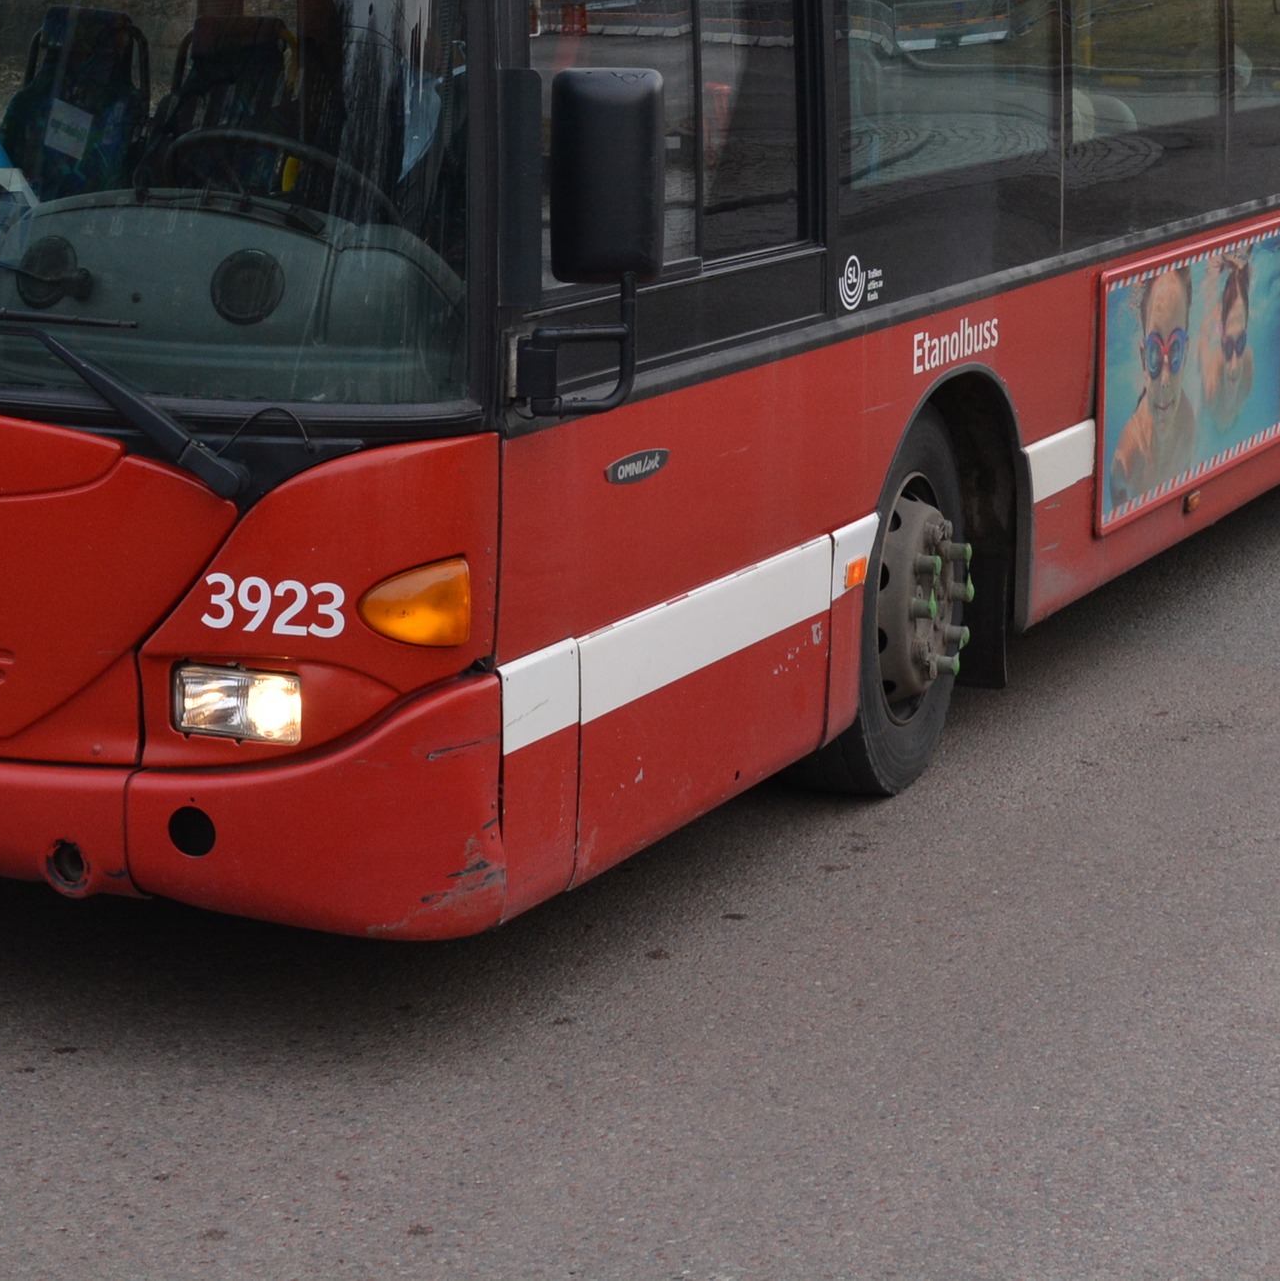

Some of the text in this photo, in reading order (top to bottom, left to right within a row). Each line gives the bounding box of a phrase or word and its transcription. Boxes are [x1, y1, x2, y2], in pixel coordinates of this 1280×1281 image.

[847, 266, 858, 284] SL
[913, 317, 999, 375] Etanolbuss
[201, 572, 345, 638] 3923
